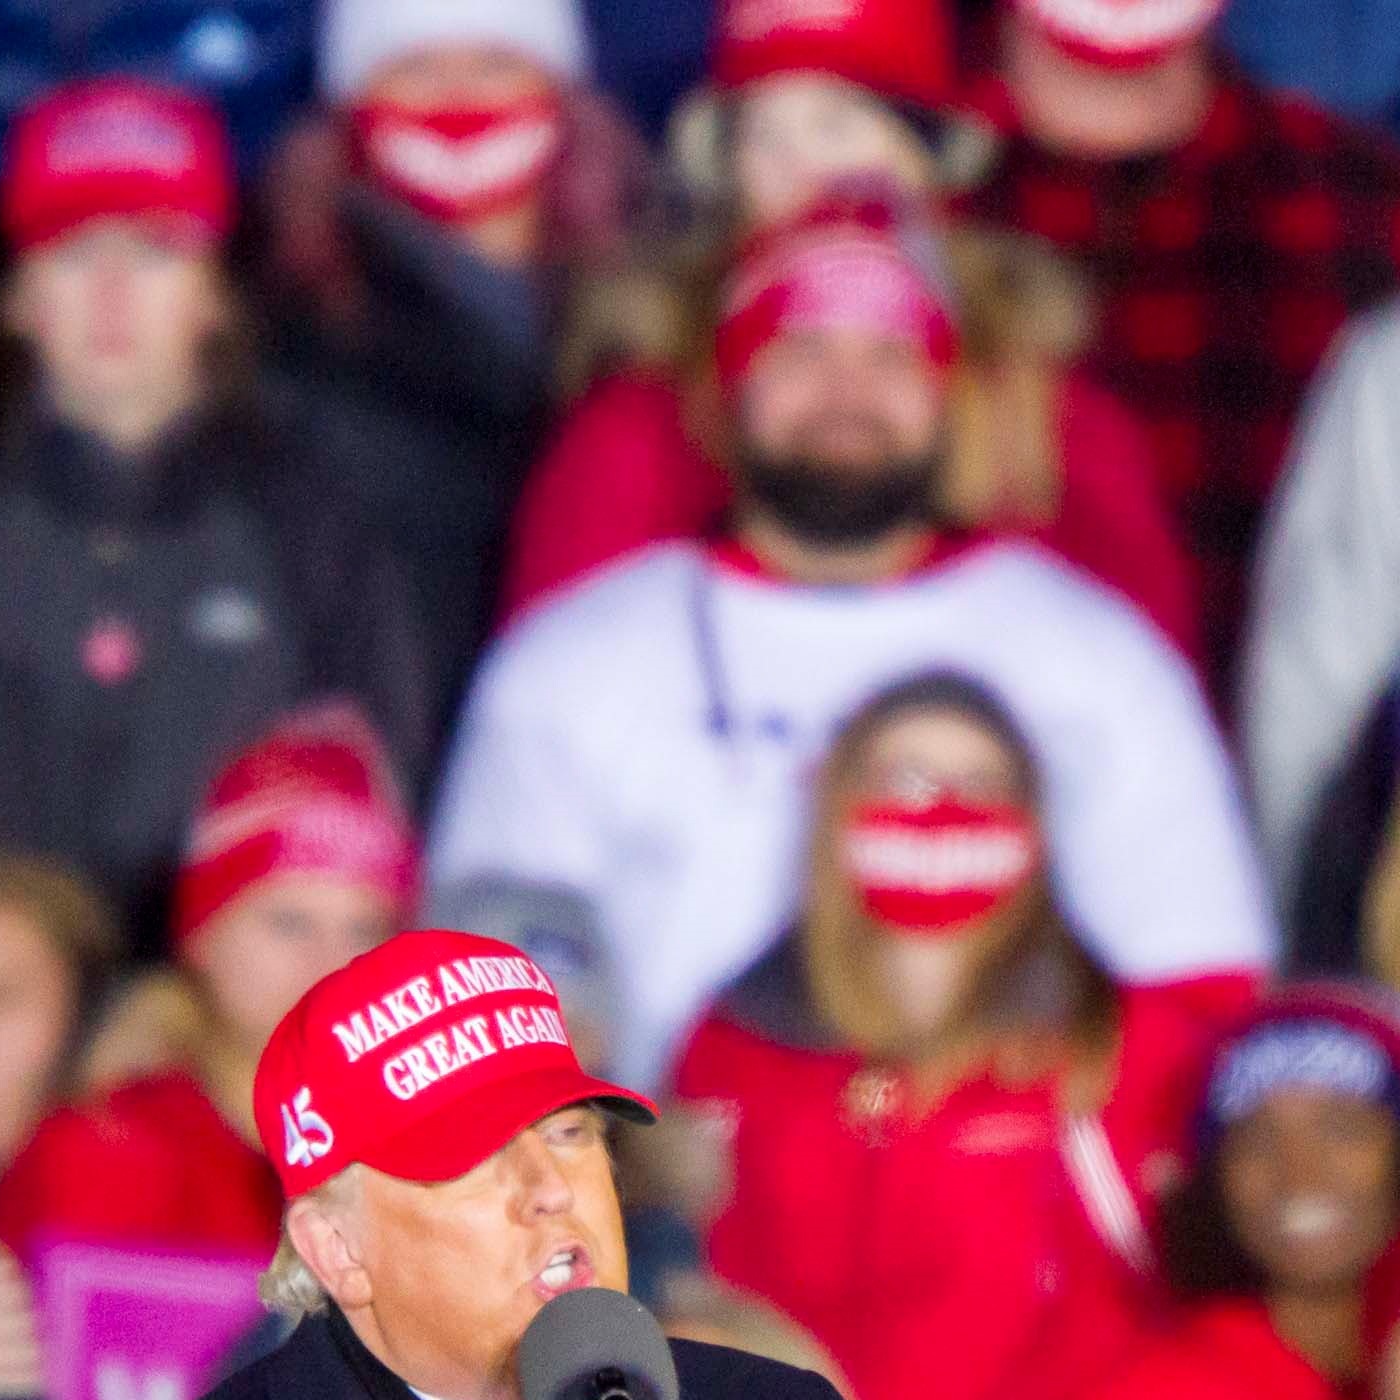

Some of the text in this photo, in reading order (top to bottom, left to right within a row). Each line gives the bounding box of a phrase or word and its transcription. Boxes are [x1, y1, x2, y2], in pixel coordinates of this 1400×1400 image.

[332, 956, 555, 1062] MAKE AMERICA
[383, 1014, 498, 1101] GREAT
[280, 1087, 334, 1167] 45
